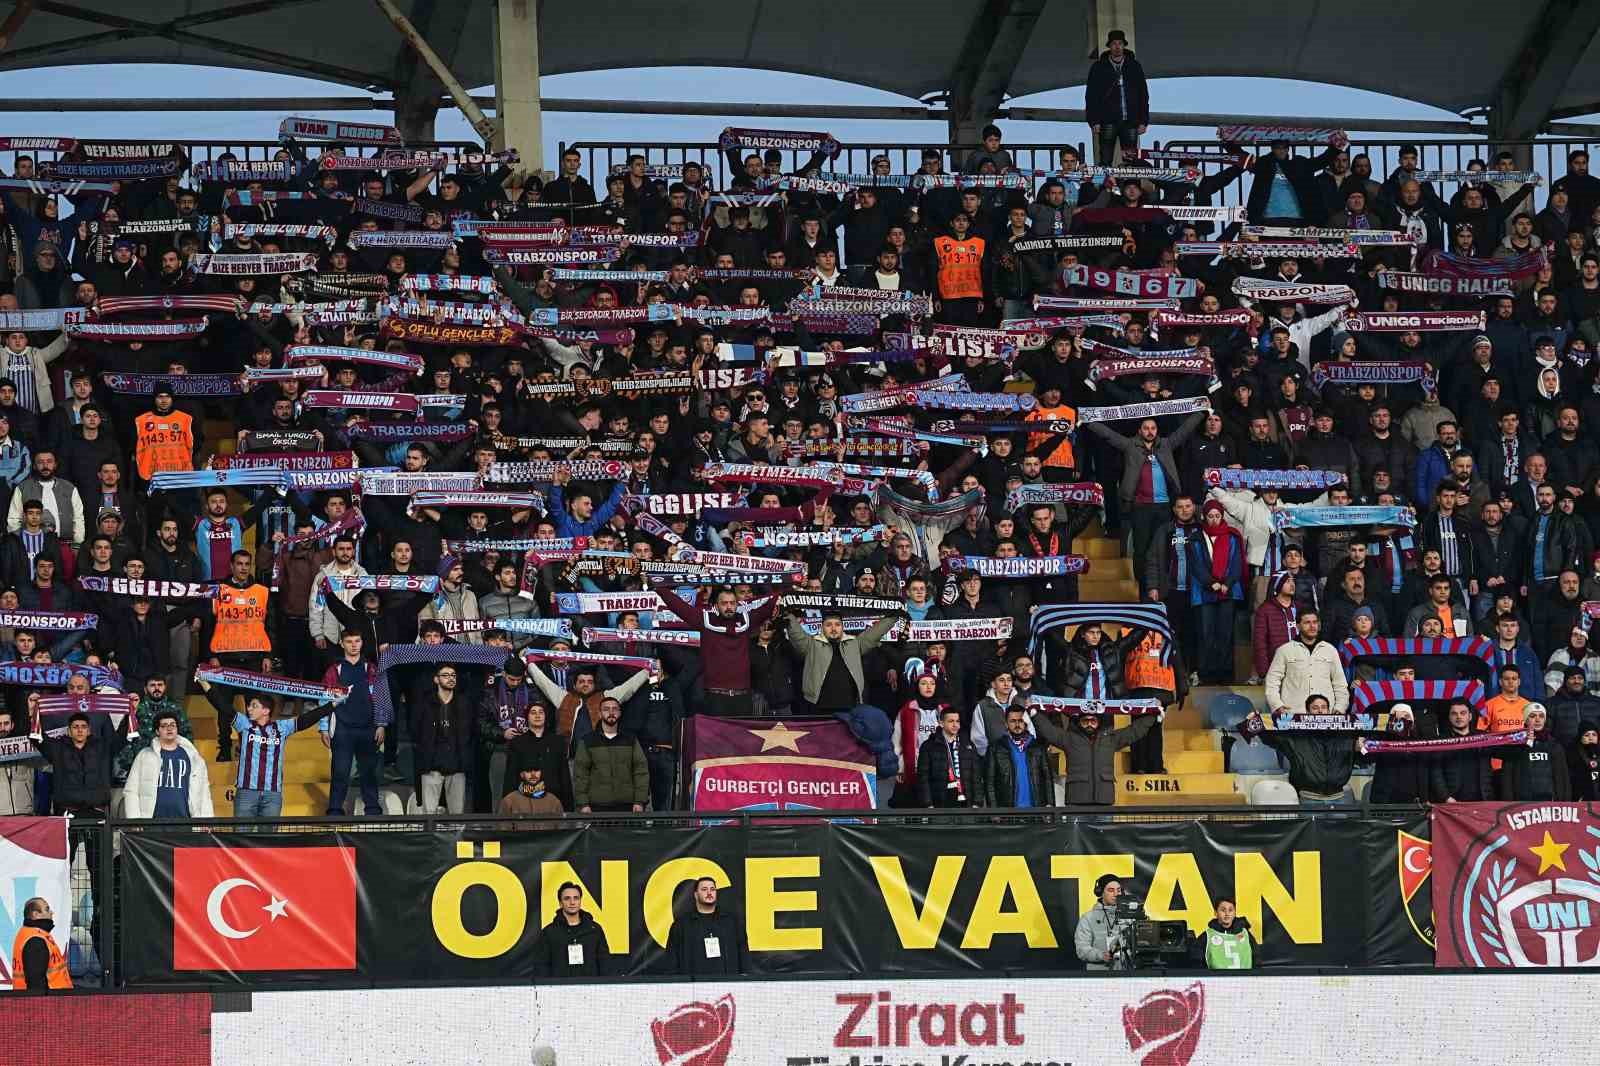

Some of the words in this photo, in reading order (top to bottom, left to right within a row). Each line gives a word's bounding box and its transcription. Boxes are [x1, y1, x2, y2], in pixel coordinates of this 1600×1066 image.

[739, 136, 821, 149] TRABZONSPOR
[84, 144, 150, 157] DEPLASMAN
[152, 144, 173, 156] YAP
[791, 178, 850, 193] TRABZON
[119, 223, 192, 234] TRABZONSPOR
[591, 234, 678, 246] TRABZONSPOR
[507, 250, 598, 263] TRABZONSPOR
[264, 262, 300, 273] TRABZON
[1249, 285, 1326, 299] TRABZON
[808, 300, 912, 313] TRABZONSPOR
[611, 309, 646, 320] TRABZON
[1160, 312, 1249, 325] TRABZONSPO
[1369, 316, 1420, 327] UNIGG
[408, 324, 441, 338] OFLU
[442, 327, 496, 342] GENÇLER
[1112, 359, 1204, 371] TRABZONSPOR
[1329, 366, 1425, 379] TRABZONSPOR
[343, 395, 394, 406] TRABZONSPOR
[372, 424, 466, 437] TRABZONSPOR
[292, 456, 333, 469] TRABZON
[751, 559, 786, 572] TRABZON
[975, 558, 1060, 575] TRABZONSPOR
[337, 579, 433, 590] TRABZON
[599, 598, 658, 611] TRABZON
[844, 621, 866, 630] ORDO
[913, 628, 933, 640] HER
[934, 628, 953, 639] YER
[954, 627, 997, 639] TRABZON
[256, 680, 285, 691] BORDO
[248, 734, 280, 746] papara
[705, 778, 783, 797] GURBETÇİ
[787, 780, 860, 797] GENÇLER
[1126, 781, 1140, 793] 6.
[1144, 780, 1180, 793] SIRA
[1506, 806, 1580, 831] İSTANBUL
[431, 841, 823, 959] ÖNCE
[869, 851, 1323, 949] VATAN
[1524, 900, 1592, 929] UNI
[1224, 940, 1242, 968] 5
[833, 991, 1025, 1047] Ziraat
